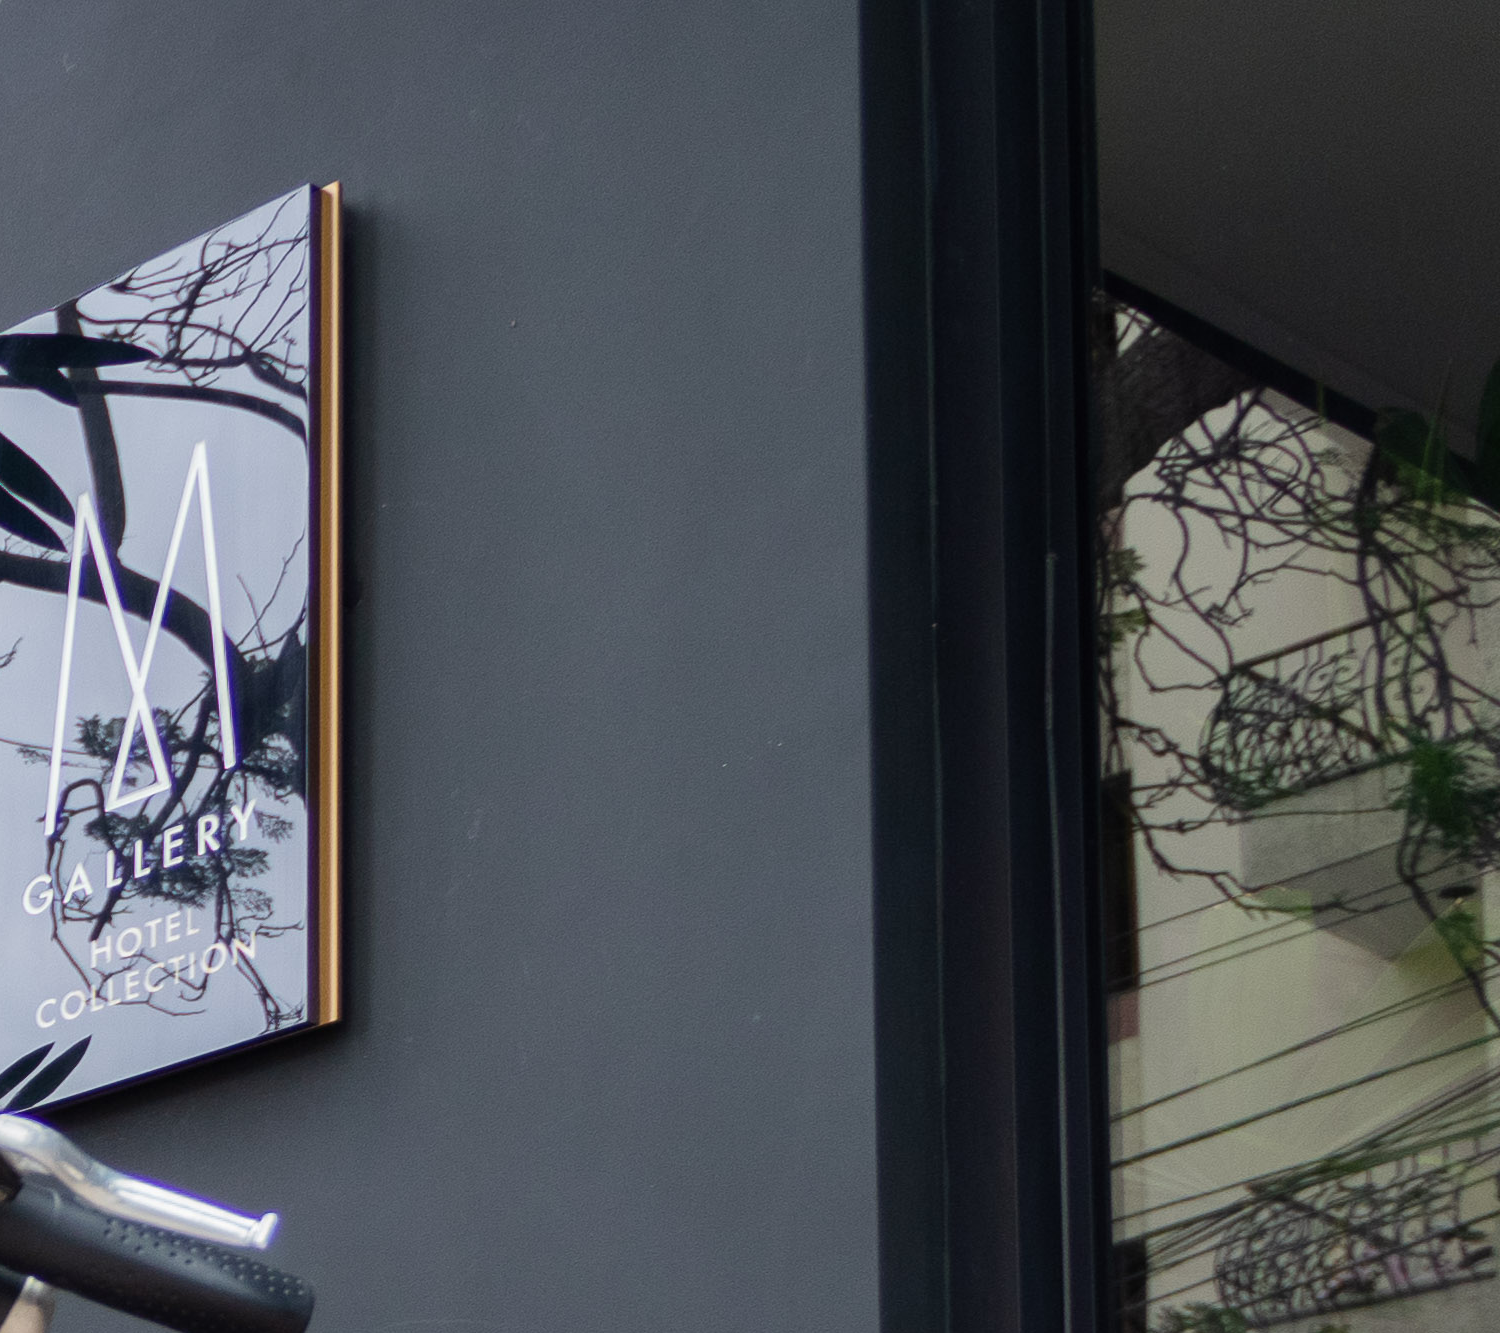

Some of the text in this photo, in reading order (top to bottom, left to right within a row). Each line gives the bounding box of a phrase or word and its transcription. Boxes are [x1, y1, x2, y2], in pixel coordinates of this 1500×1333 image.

[22, 799, 257, 916] GALLERY
[35, 931, 257, 1028] COLLECTION
[90, 907, 200, 968] HOTEL
